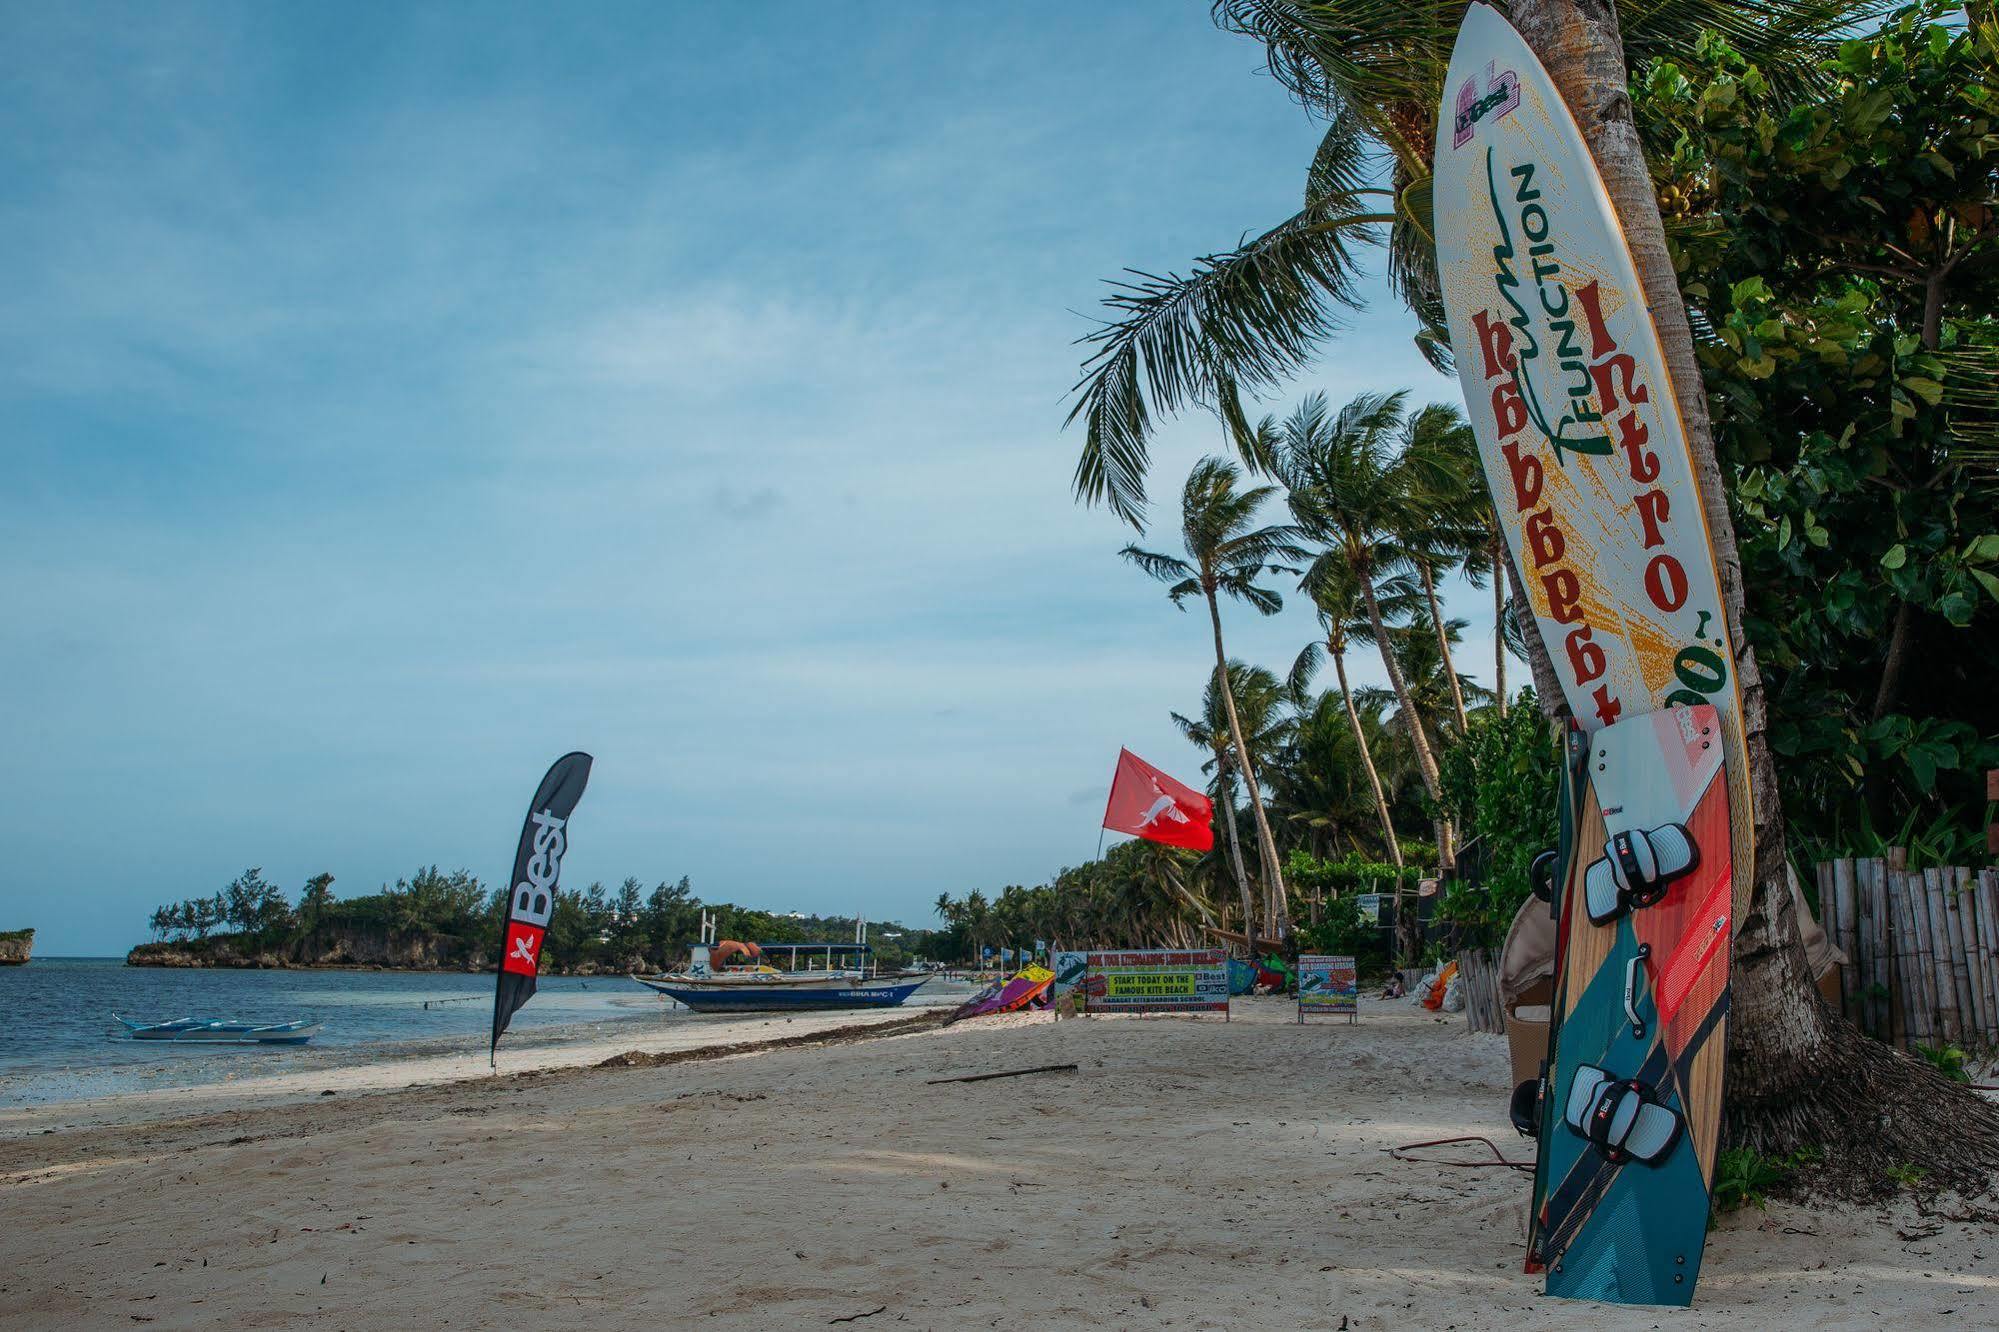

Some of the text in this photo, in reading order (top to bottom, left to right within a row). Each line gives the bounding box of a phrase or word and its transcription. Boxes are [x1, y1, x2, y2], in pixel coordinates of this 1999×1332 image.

[1511, 164, 1602, 423] FUNCTION
[1576, 279, 1688, 612] Intro
[511, 808, 566, 927] Best
[1114, 975, 1189, 984] START TODAY ON THE
[1115, 986, 1145, 994] FAMOUS
[1147, 986, 1164, 994] KITE
[1165, 986, 1189, 994] BEACH
[1203, 972, 1226, 980] Best
